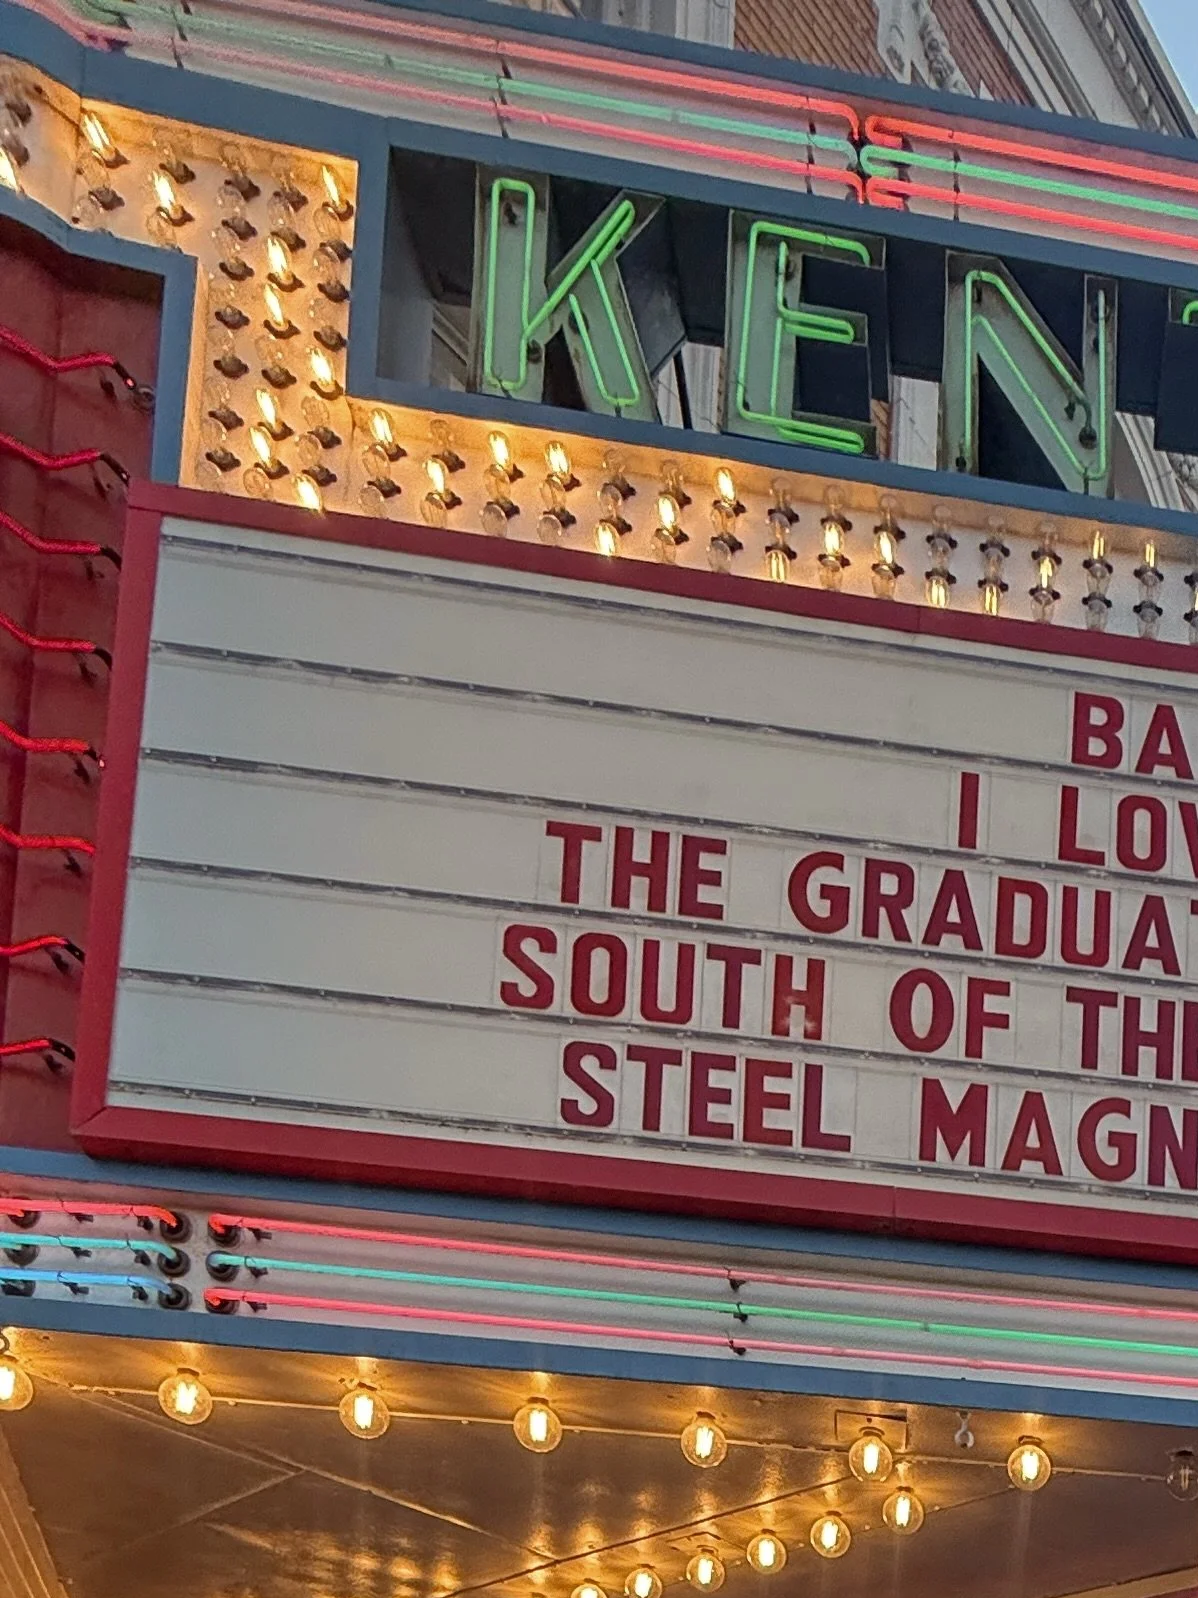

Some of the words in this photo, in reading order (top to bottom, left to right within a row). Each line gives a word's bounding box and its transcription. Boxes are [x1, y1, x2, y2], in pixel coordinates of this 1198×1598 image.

[959, 772, 980, 849] I
[546, 820, 727, 920] THE
[499, 924, 827, 1041] SOUTH
[889, 968, 1010, 1060] OF
[560, 1041, 851, 1152] STEEL
